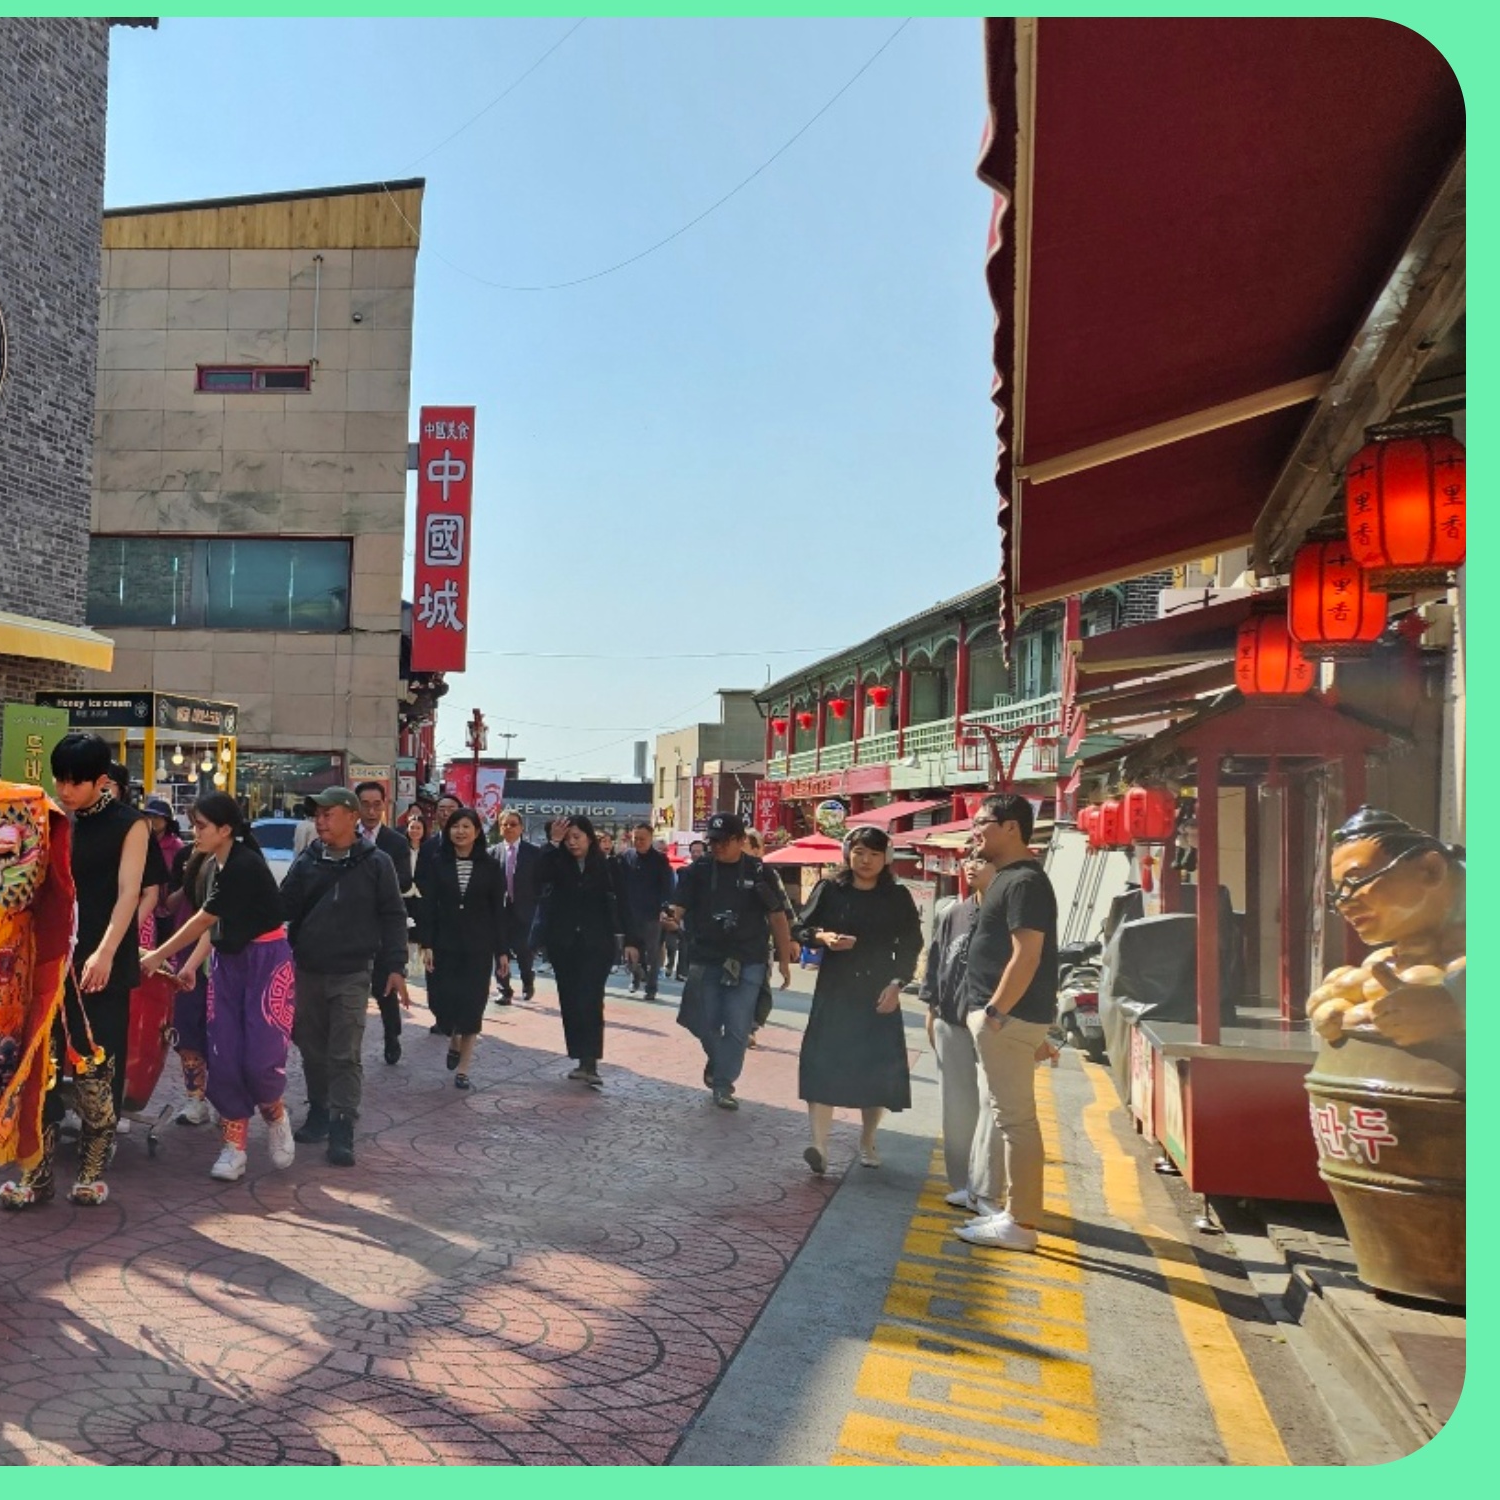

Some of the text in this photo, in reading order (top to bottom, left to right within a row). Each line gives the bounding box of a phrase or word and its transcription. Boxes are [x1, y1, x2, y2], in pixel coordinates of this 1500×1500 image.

[424, 420, 470, 440] 中國美食
[1350, 462, 1375, 547] 十里香
[1434, 457, 1465, 540] 十里香
[417, 449, 467, 632] 中國城
[1327, 553, 1352, 622] 十里香
[103, 699, 133, 708] cream
[541, 804, 616, 816] CONTIGO
[1311, 1103, 1399, 1164] 만두
